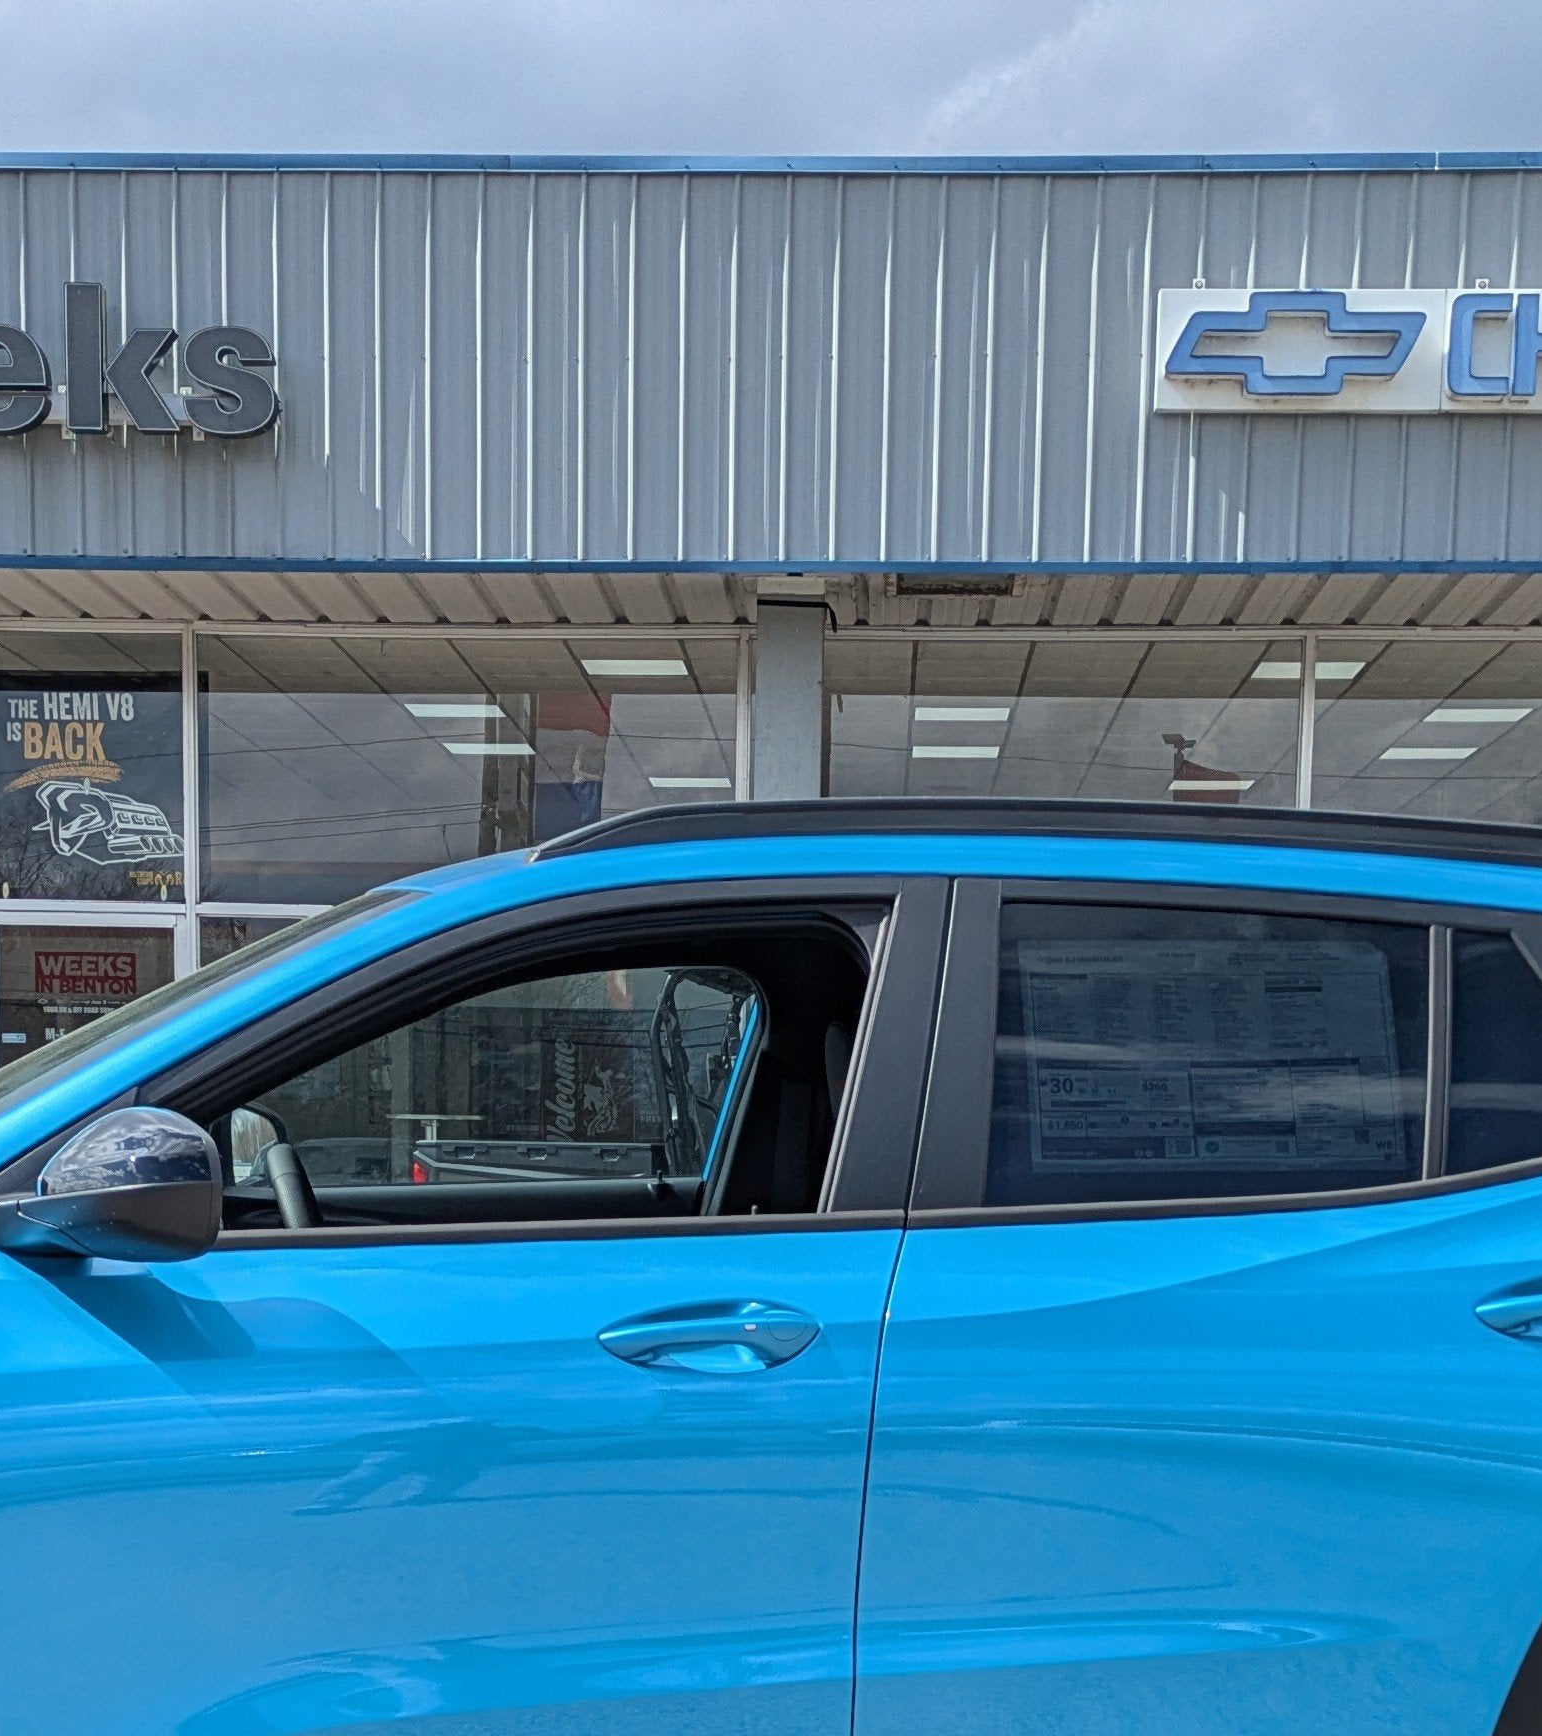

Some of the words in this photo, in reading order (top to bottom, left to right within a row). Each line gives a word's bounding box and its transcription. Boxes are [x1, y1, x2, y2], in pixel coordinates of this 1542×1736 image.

[8, 698, 39, 719] THE
[43, 691, 100, 721] HEMI
[105, 692, 135, 722] V8
[6, 721, 22, 742] IS
[23, 721, 107, 760] BACK
[37, 955, 133, 978] WEEKS
[35, 978, 54, 994] IN
[59, 979, 138, 995] BENTON
[1049, 1077, 1074, 1094] 30
